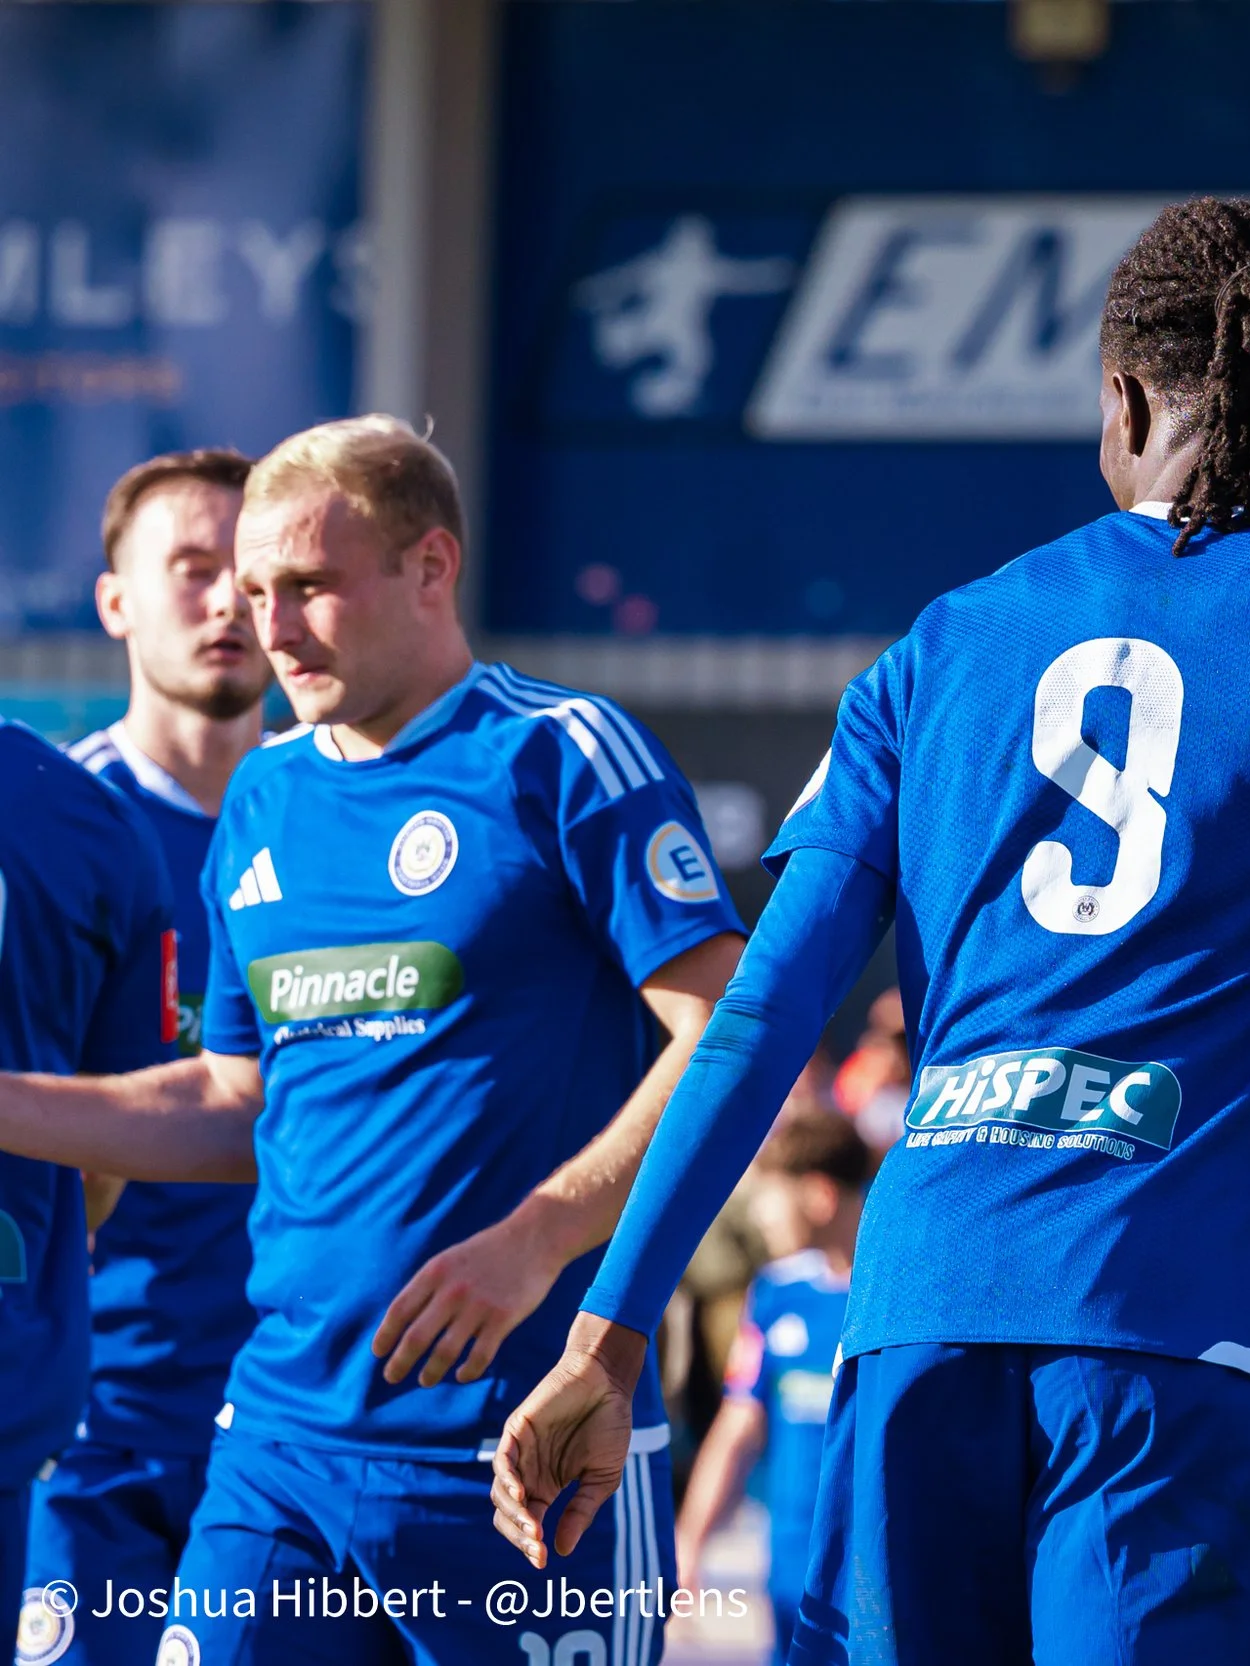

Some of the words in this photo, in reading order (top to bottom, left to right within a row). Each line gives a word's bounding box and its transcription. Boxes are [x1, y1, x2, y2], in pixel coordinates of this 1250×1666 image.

[1020, 637, 1185, 935] 9
[669, 845, 705, 882] E
[270, 955, 420, 1013] Pinnacle
[354, 1016, 426, 1041] Supplies
[990, 1126, 1055, 1149] HOUSING
[1057, 1133, 1135, 1161] SOLUTIONS
